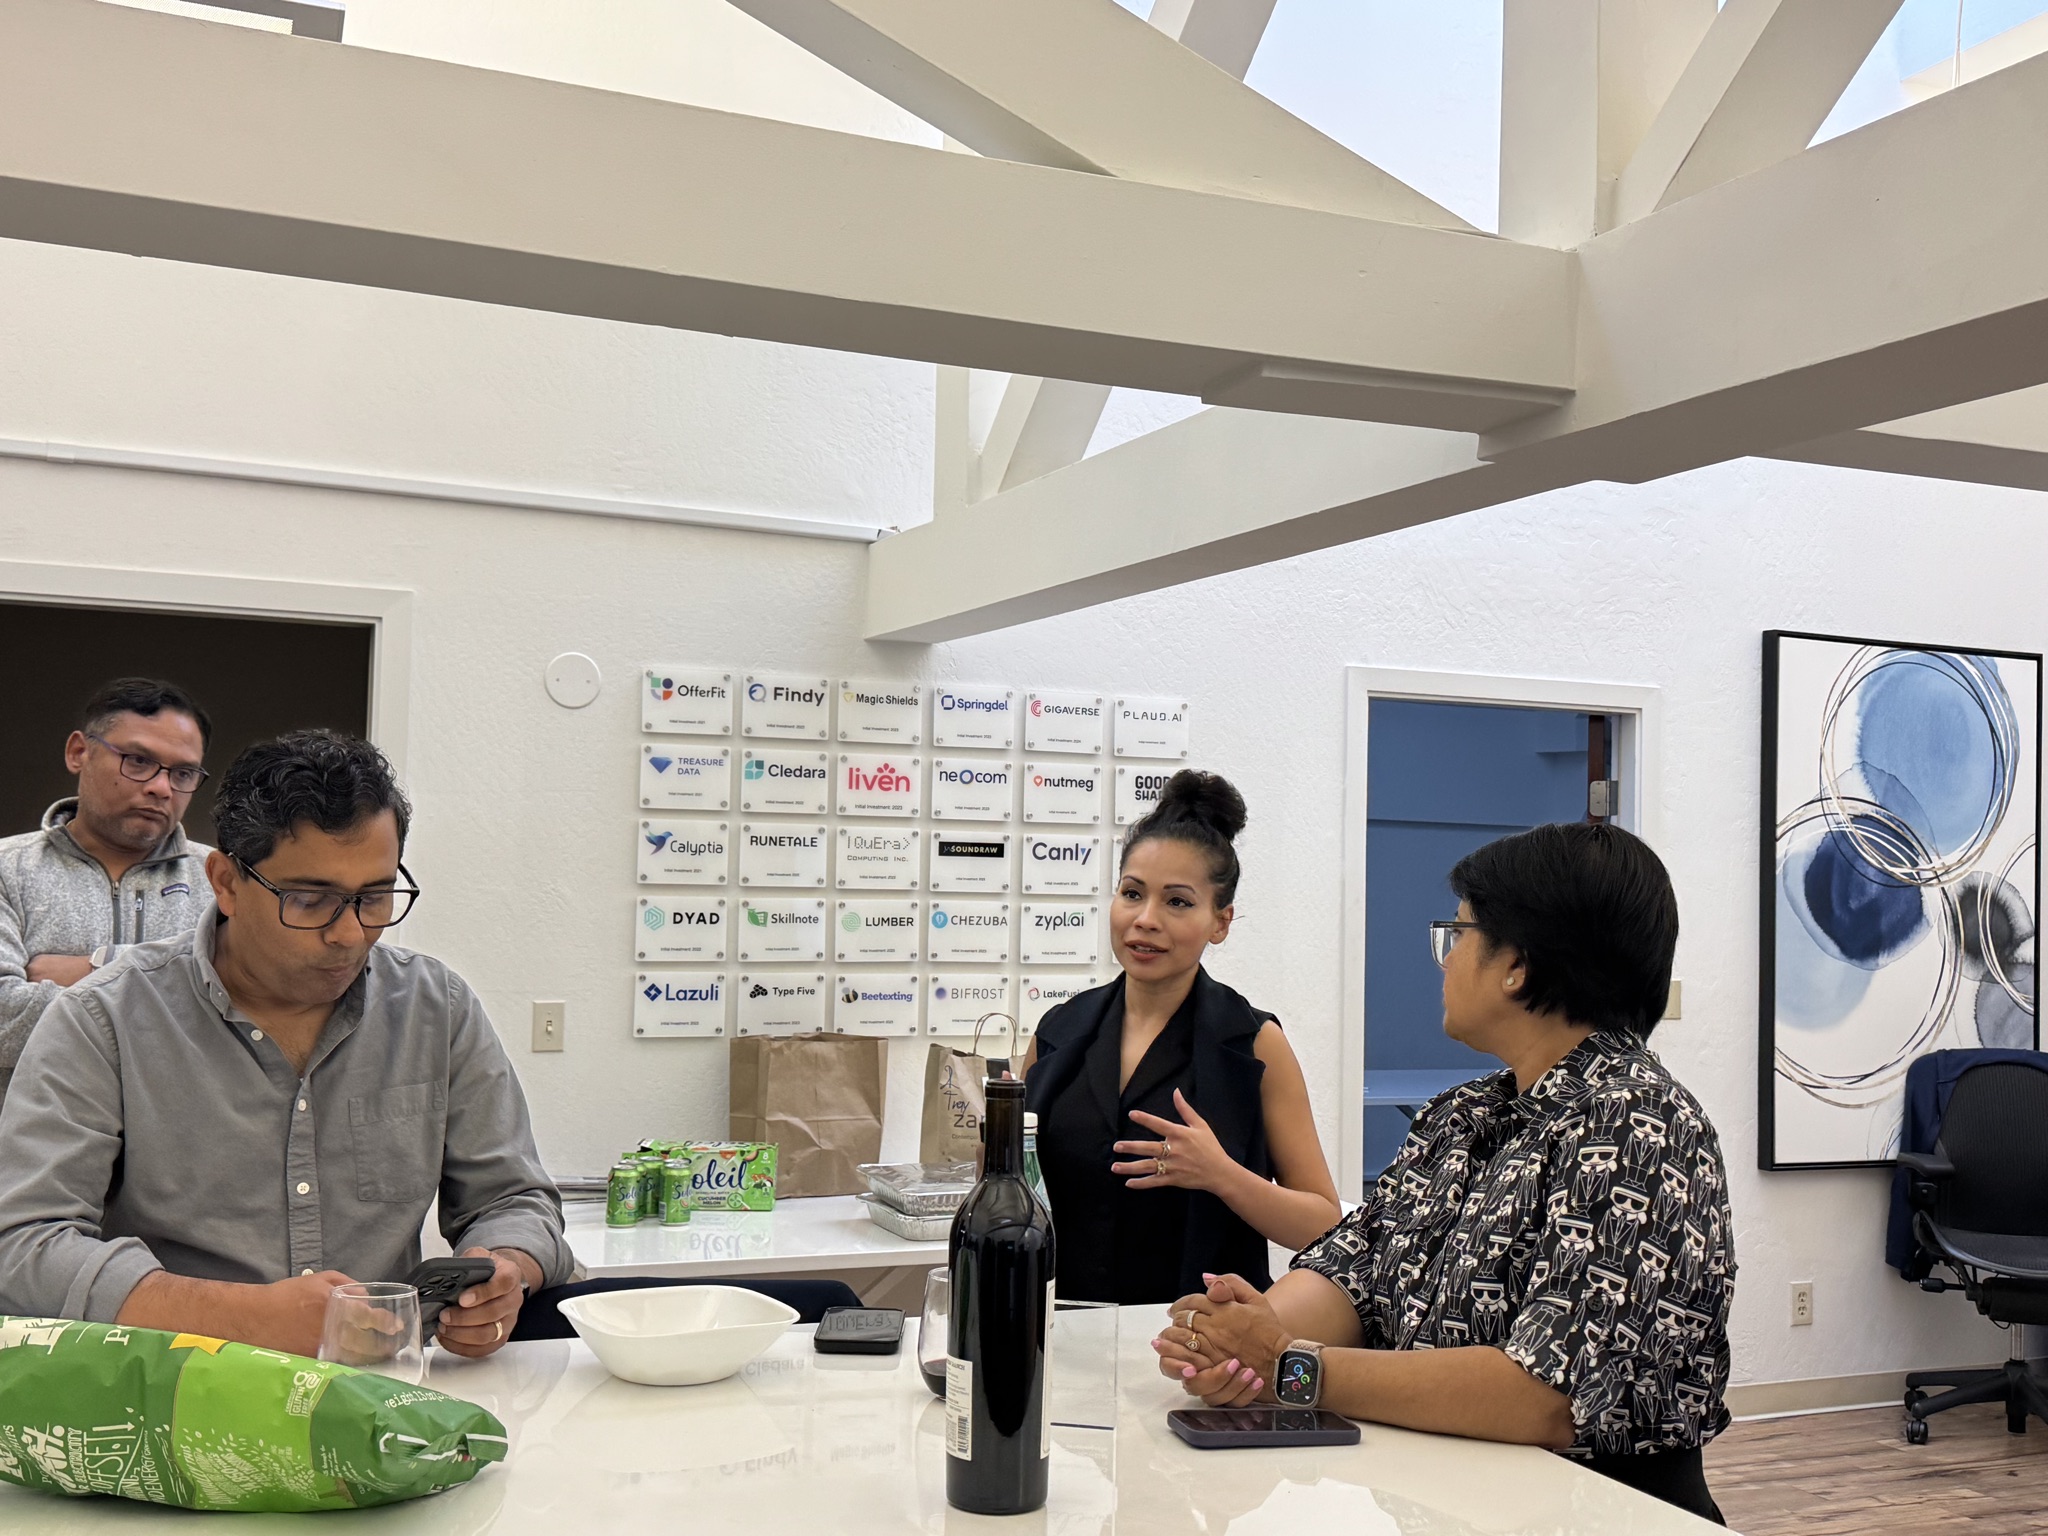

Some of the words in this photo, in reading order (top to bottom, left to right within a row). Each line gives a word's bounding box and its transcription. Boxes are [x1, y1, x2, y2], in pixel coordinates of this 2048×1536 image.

[677, 685, 726, 699] OfferFit
[773, 687, 825, 706] Findy
[855, 693, 885, 705] Magic
[885, 694, 919, 706] Shields
[957, 698, 1009, 712] Springdel
[1044, 705, 1100, 717] GIGAVERSE
[678, 757, 725, 767] TREASURE
[677, 767, 701, 776] DATA
[768, 764, 826, 779] Cledara
[848, 766, 911, 792] liven
[1044, 776, 1094, 791] nutmeg
[1135, 790, 1162, 801] SHA
[670, 840, 724, 856] Calyptia
[750, 835, 818, 848] RUNETALE
[951, 845, 998, 854] SOUNDRAW
[1032, 842, 1092, 865] Canly
[672, 912, 720, 925] DYAD
[771, 913, 819, 924] Skillnote
[865, 917, 914, 927] LUMBER
[951, 915, 1008, 926] CHEZUBA
[1035, 911, 1084, 931] zypl.ai
[666, 984, 719, 1001] Lazuli
[772, 987, 795, 998] Type
[797, 987, 816, 997] Five
[861, 991, 913, 1002] Beetexting
[951, 988, 1005, 999] BIFROST
[292, 1386, 306, 1413] GLUTEN
